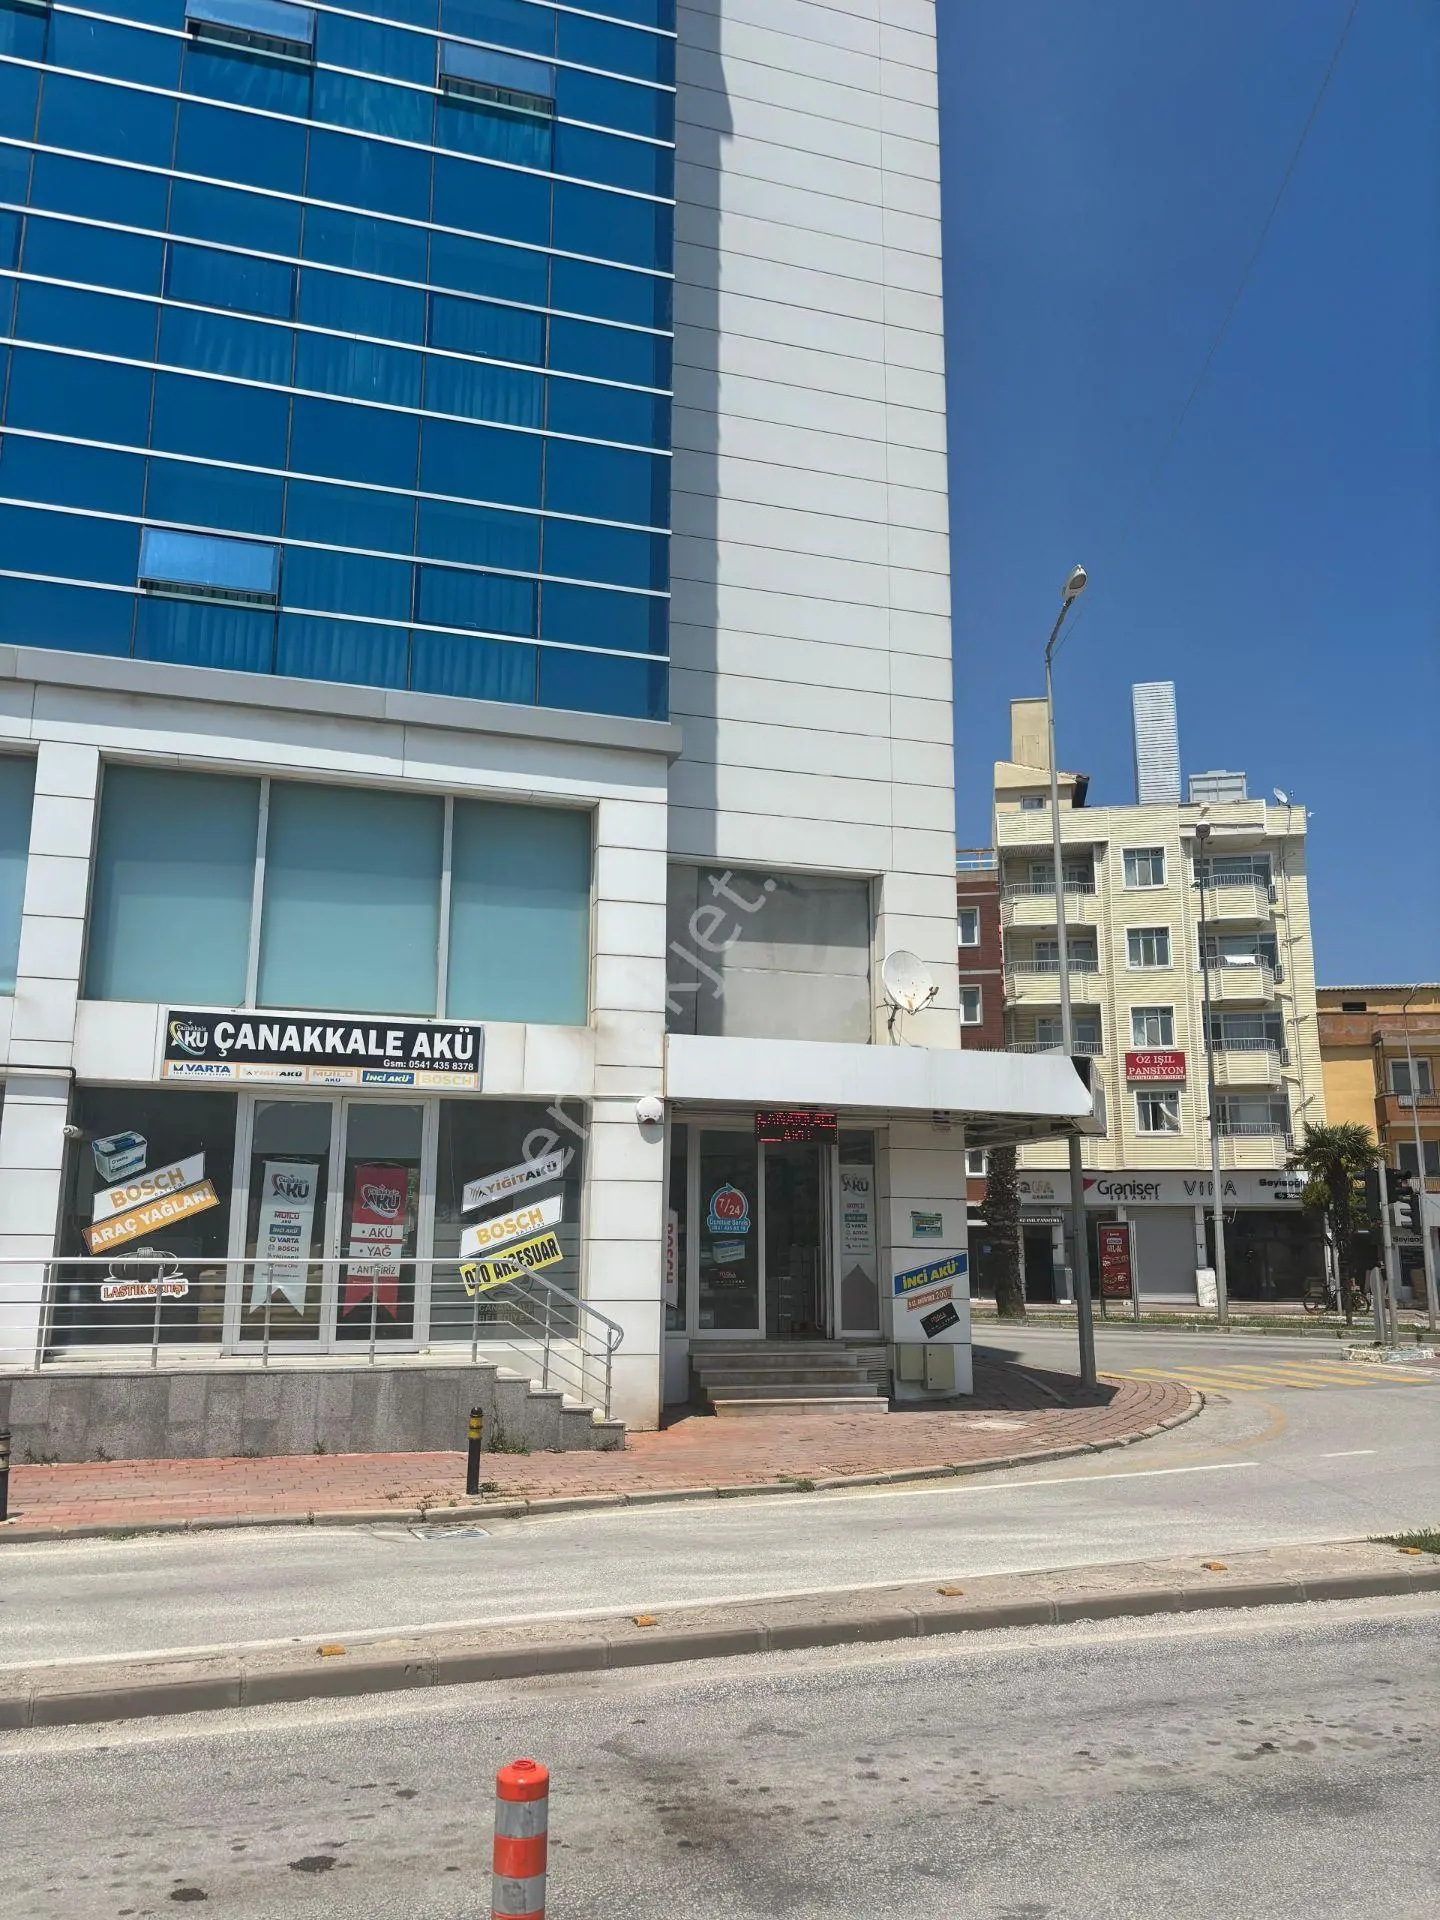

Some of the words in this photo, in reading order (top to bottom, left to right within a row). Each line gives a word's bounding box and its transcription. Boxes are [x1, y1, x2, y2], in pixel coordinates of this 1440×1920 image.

[214, 1021, 403, 1057] ÇANAKKALE
[411, 1027, 474, 1060] AKÜ
[383, 1059, 406, 1068] Gsm:
[408, 1060, 430, 1069] 0541
[433, 1061, 450, 1070] 435
[452, 1062, 474, 1071] 8378
[1136, 1053, 1151, 1064] ÖZ
[1153, 1055, 1176, 1066] IŞIL
[186, 1063, 231, 1073] VARTA
[1128, 1064, 1184, 1075] PANSİYON
[422, 1075, 472, 1085] BOSCH
[486, 1160, 558, 1194] YİĞİTAKÜ
[110, 1167, 185, 1209] BOSCH
[1097, 1180, 1162, 1195] Graniser
[719, 1198, 741, 1215] 7/24
[91, 1218, 138, 1247] ARAÇ
[139, 1186, 212, 1226] YAĞLARI
[368, 1225, 393, 1238] AKÜ
[476, 1207, 544, 1246] BOSCH
[367, 1243, 392, 1258] YAĞ
[902, 1269, 928, 1290] İNCİ
[931, 1260, 957, 1280] AKÜ
